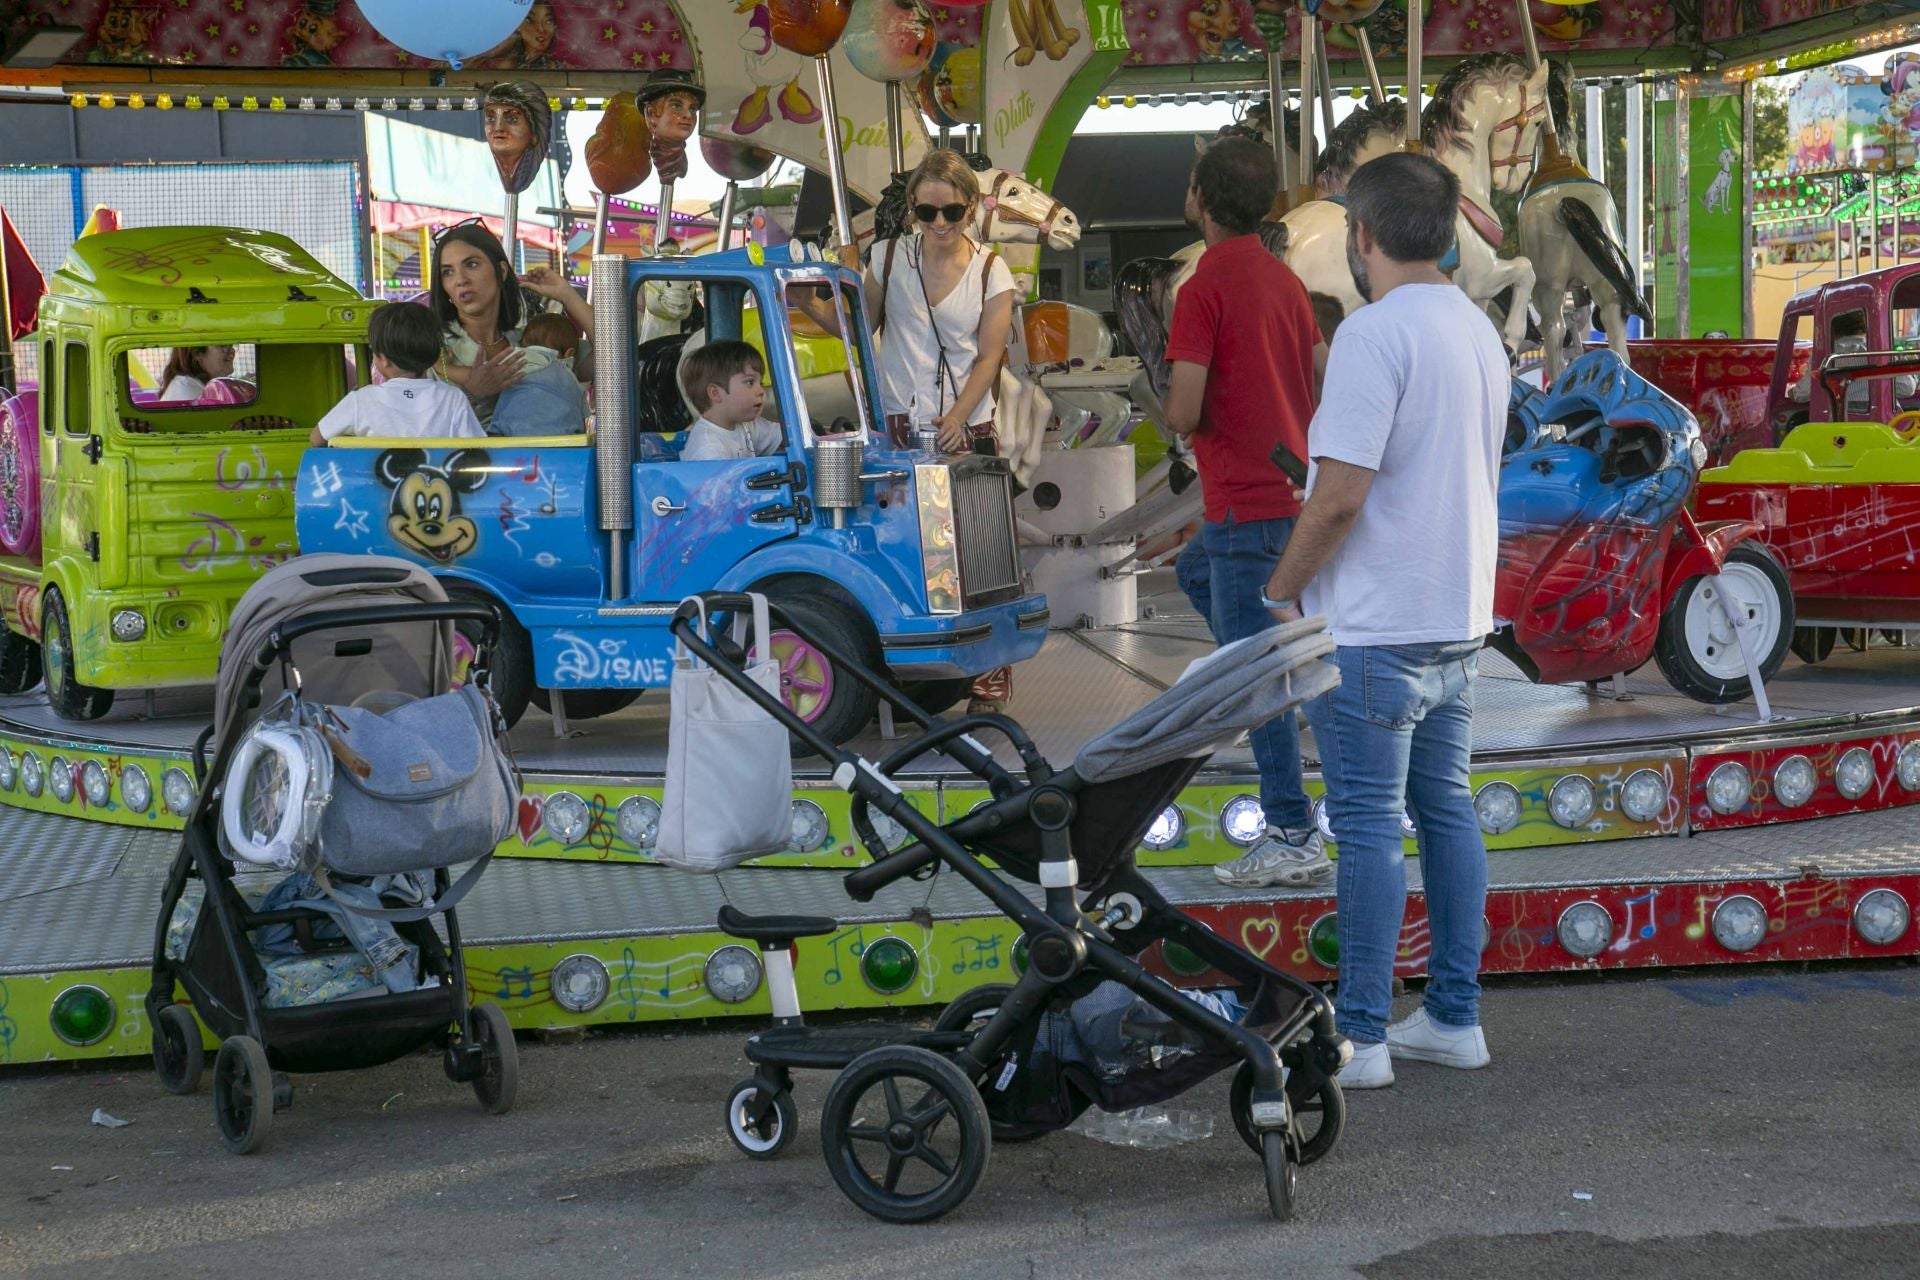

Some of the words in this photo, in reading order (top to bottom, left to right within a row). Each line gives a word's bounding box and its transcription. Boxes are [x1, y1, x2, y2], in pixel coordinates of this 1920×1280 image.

[819, 116, 912, 160] Dai
[994, 89, 1036, 149] Pluto
[1099, 505, 1106, 519] 5
